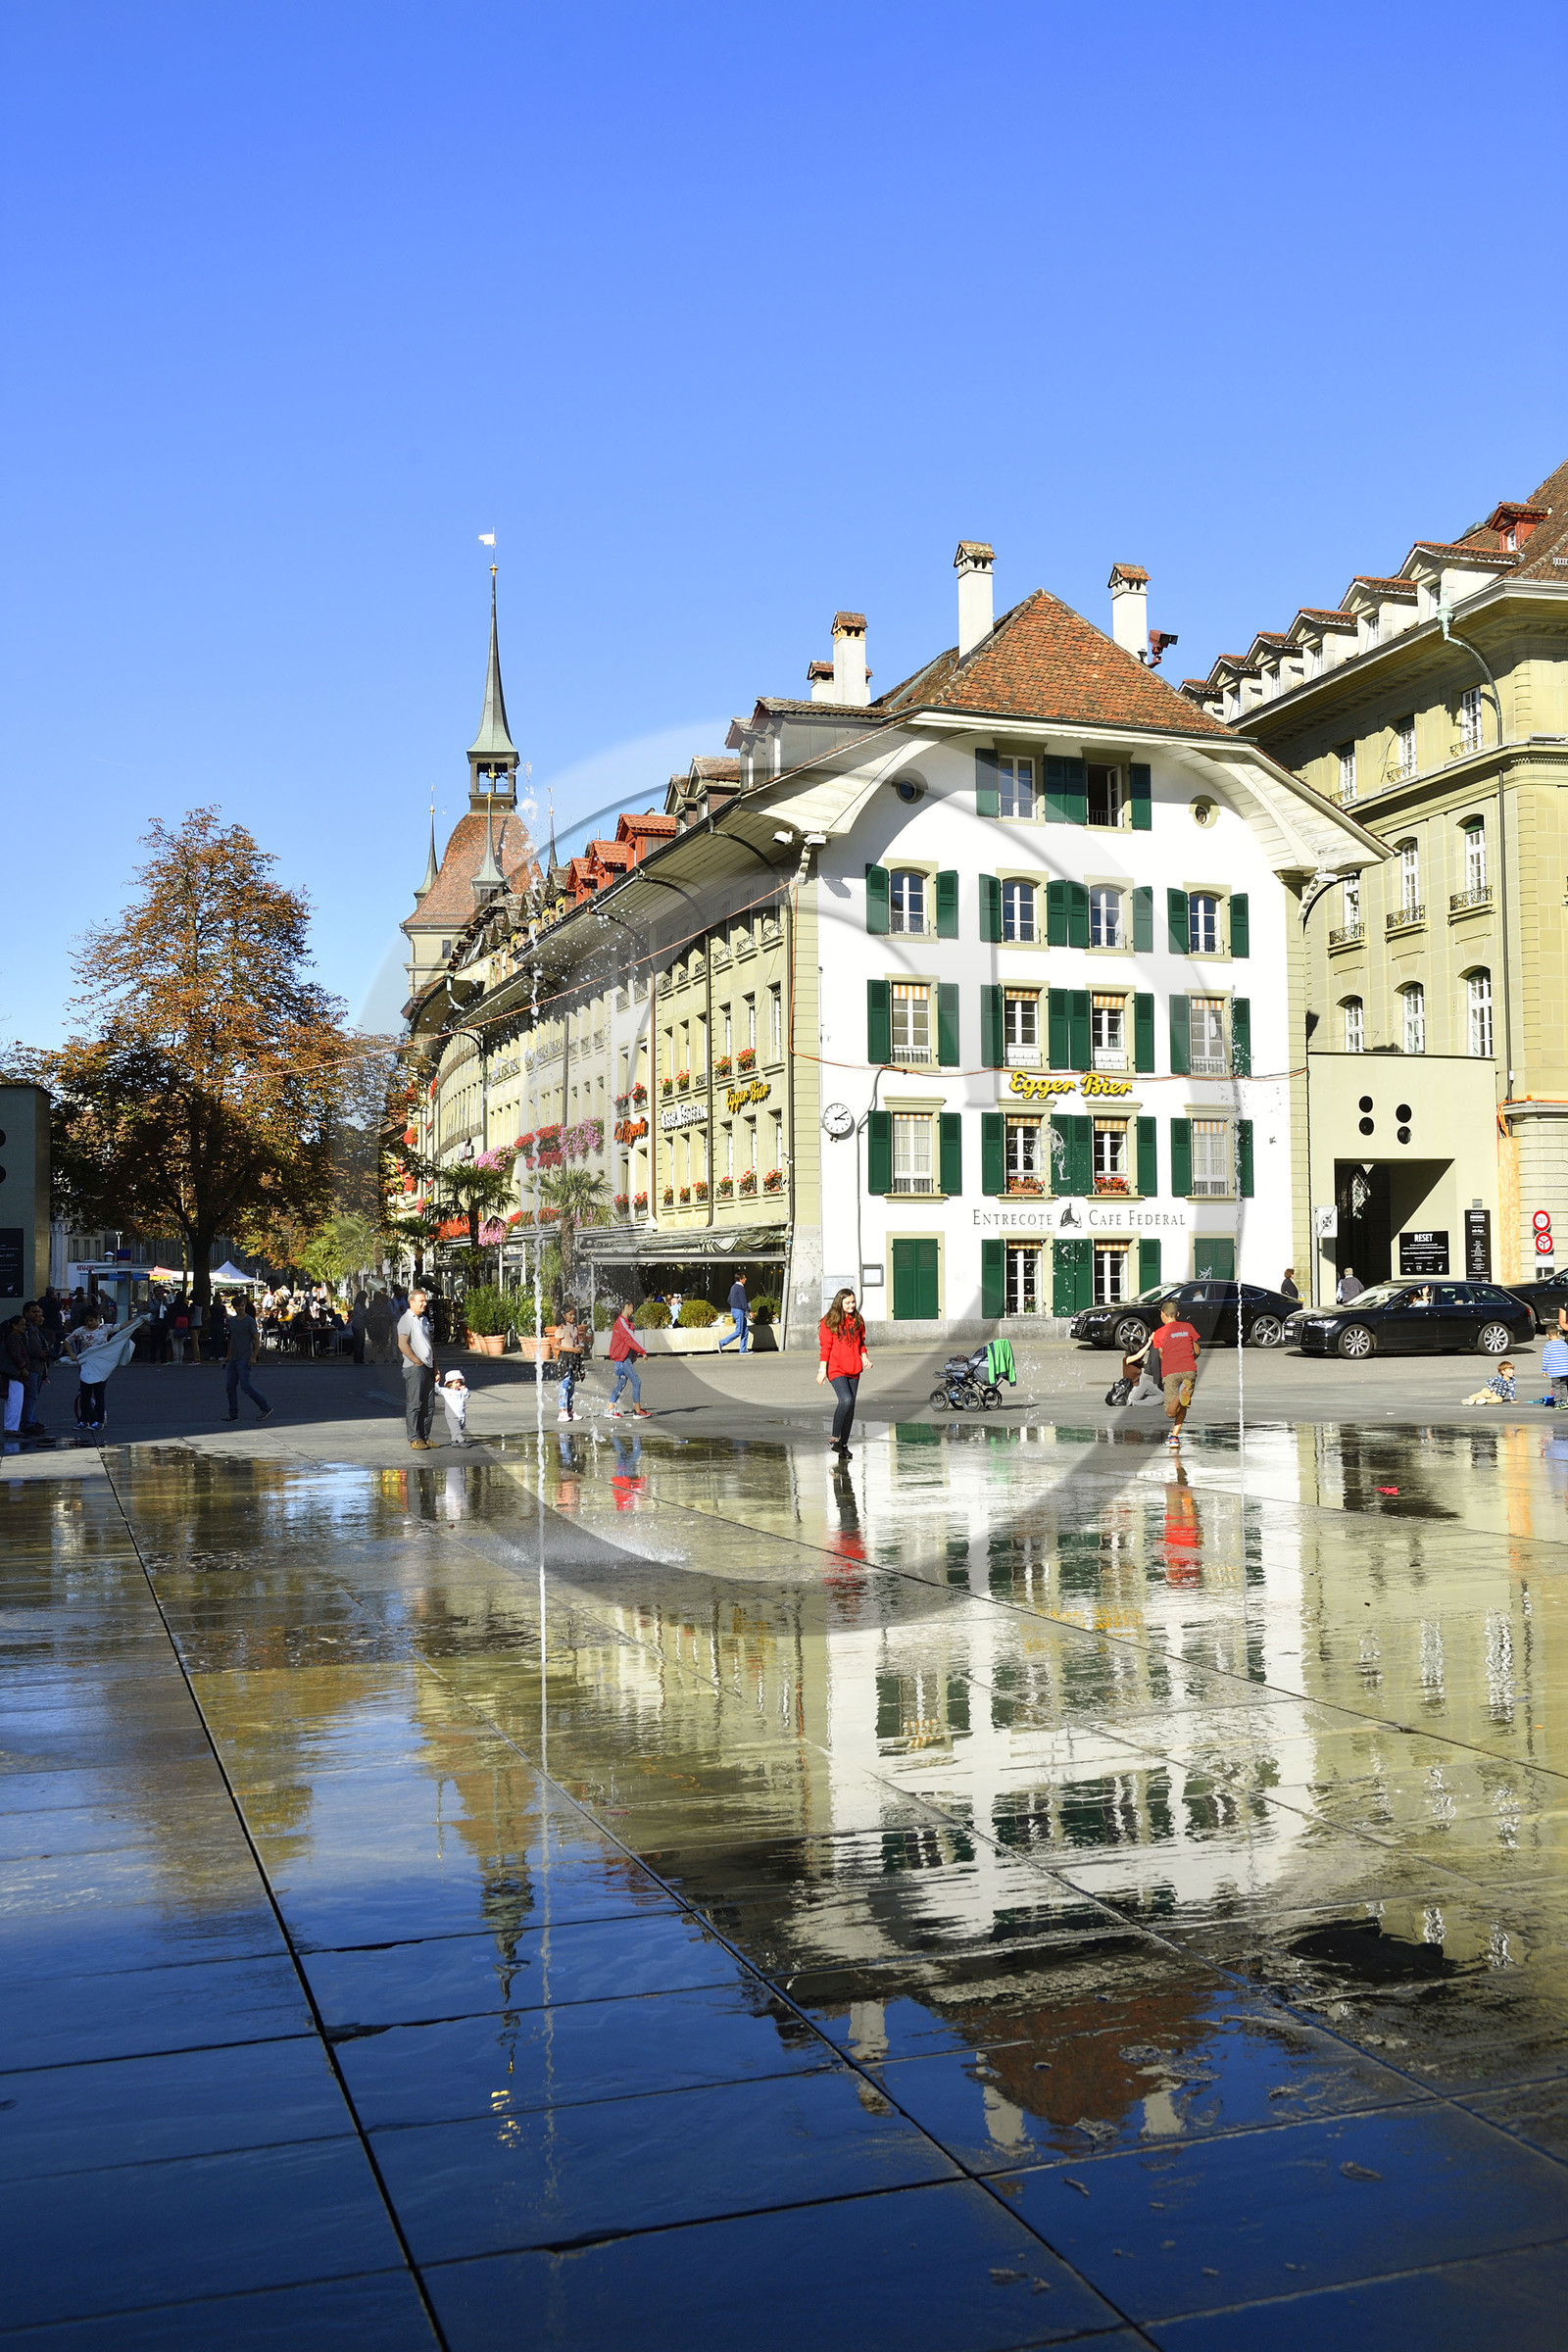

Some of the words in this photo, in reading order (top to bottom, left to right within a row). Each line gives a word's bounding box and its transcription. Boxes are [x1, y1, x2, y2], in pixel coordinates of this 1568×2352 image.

[726, 1088, 749, 1113] Egger
[750, 1081, 769, 1102] Bier
[1009, 1071, 1075, 1100] Egger
[1081, 1074, 1133, 1096] Bier
[1414, 1233, 1433, 1243] RESET
